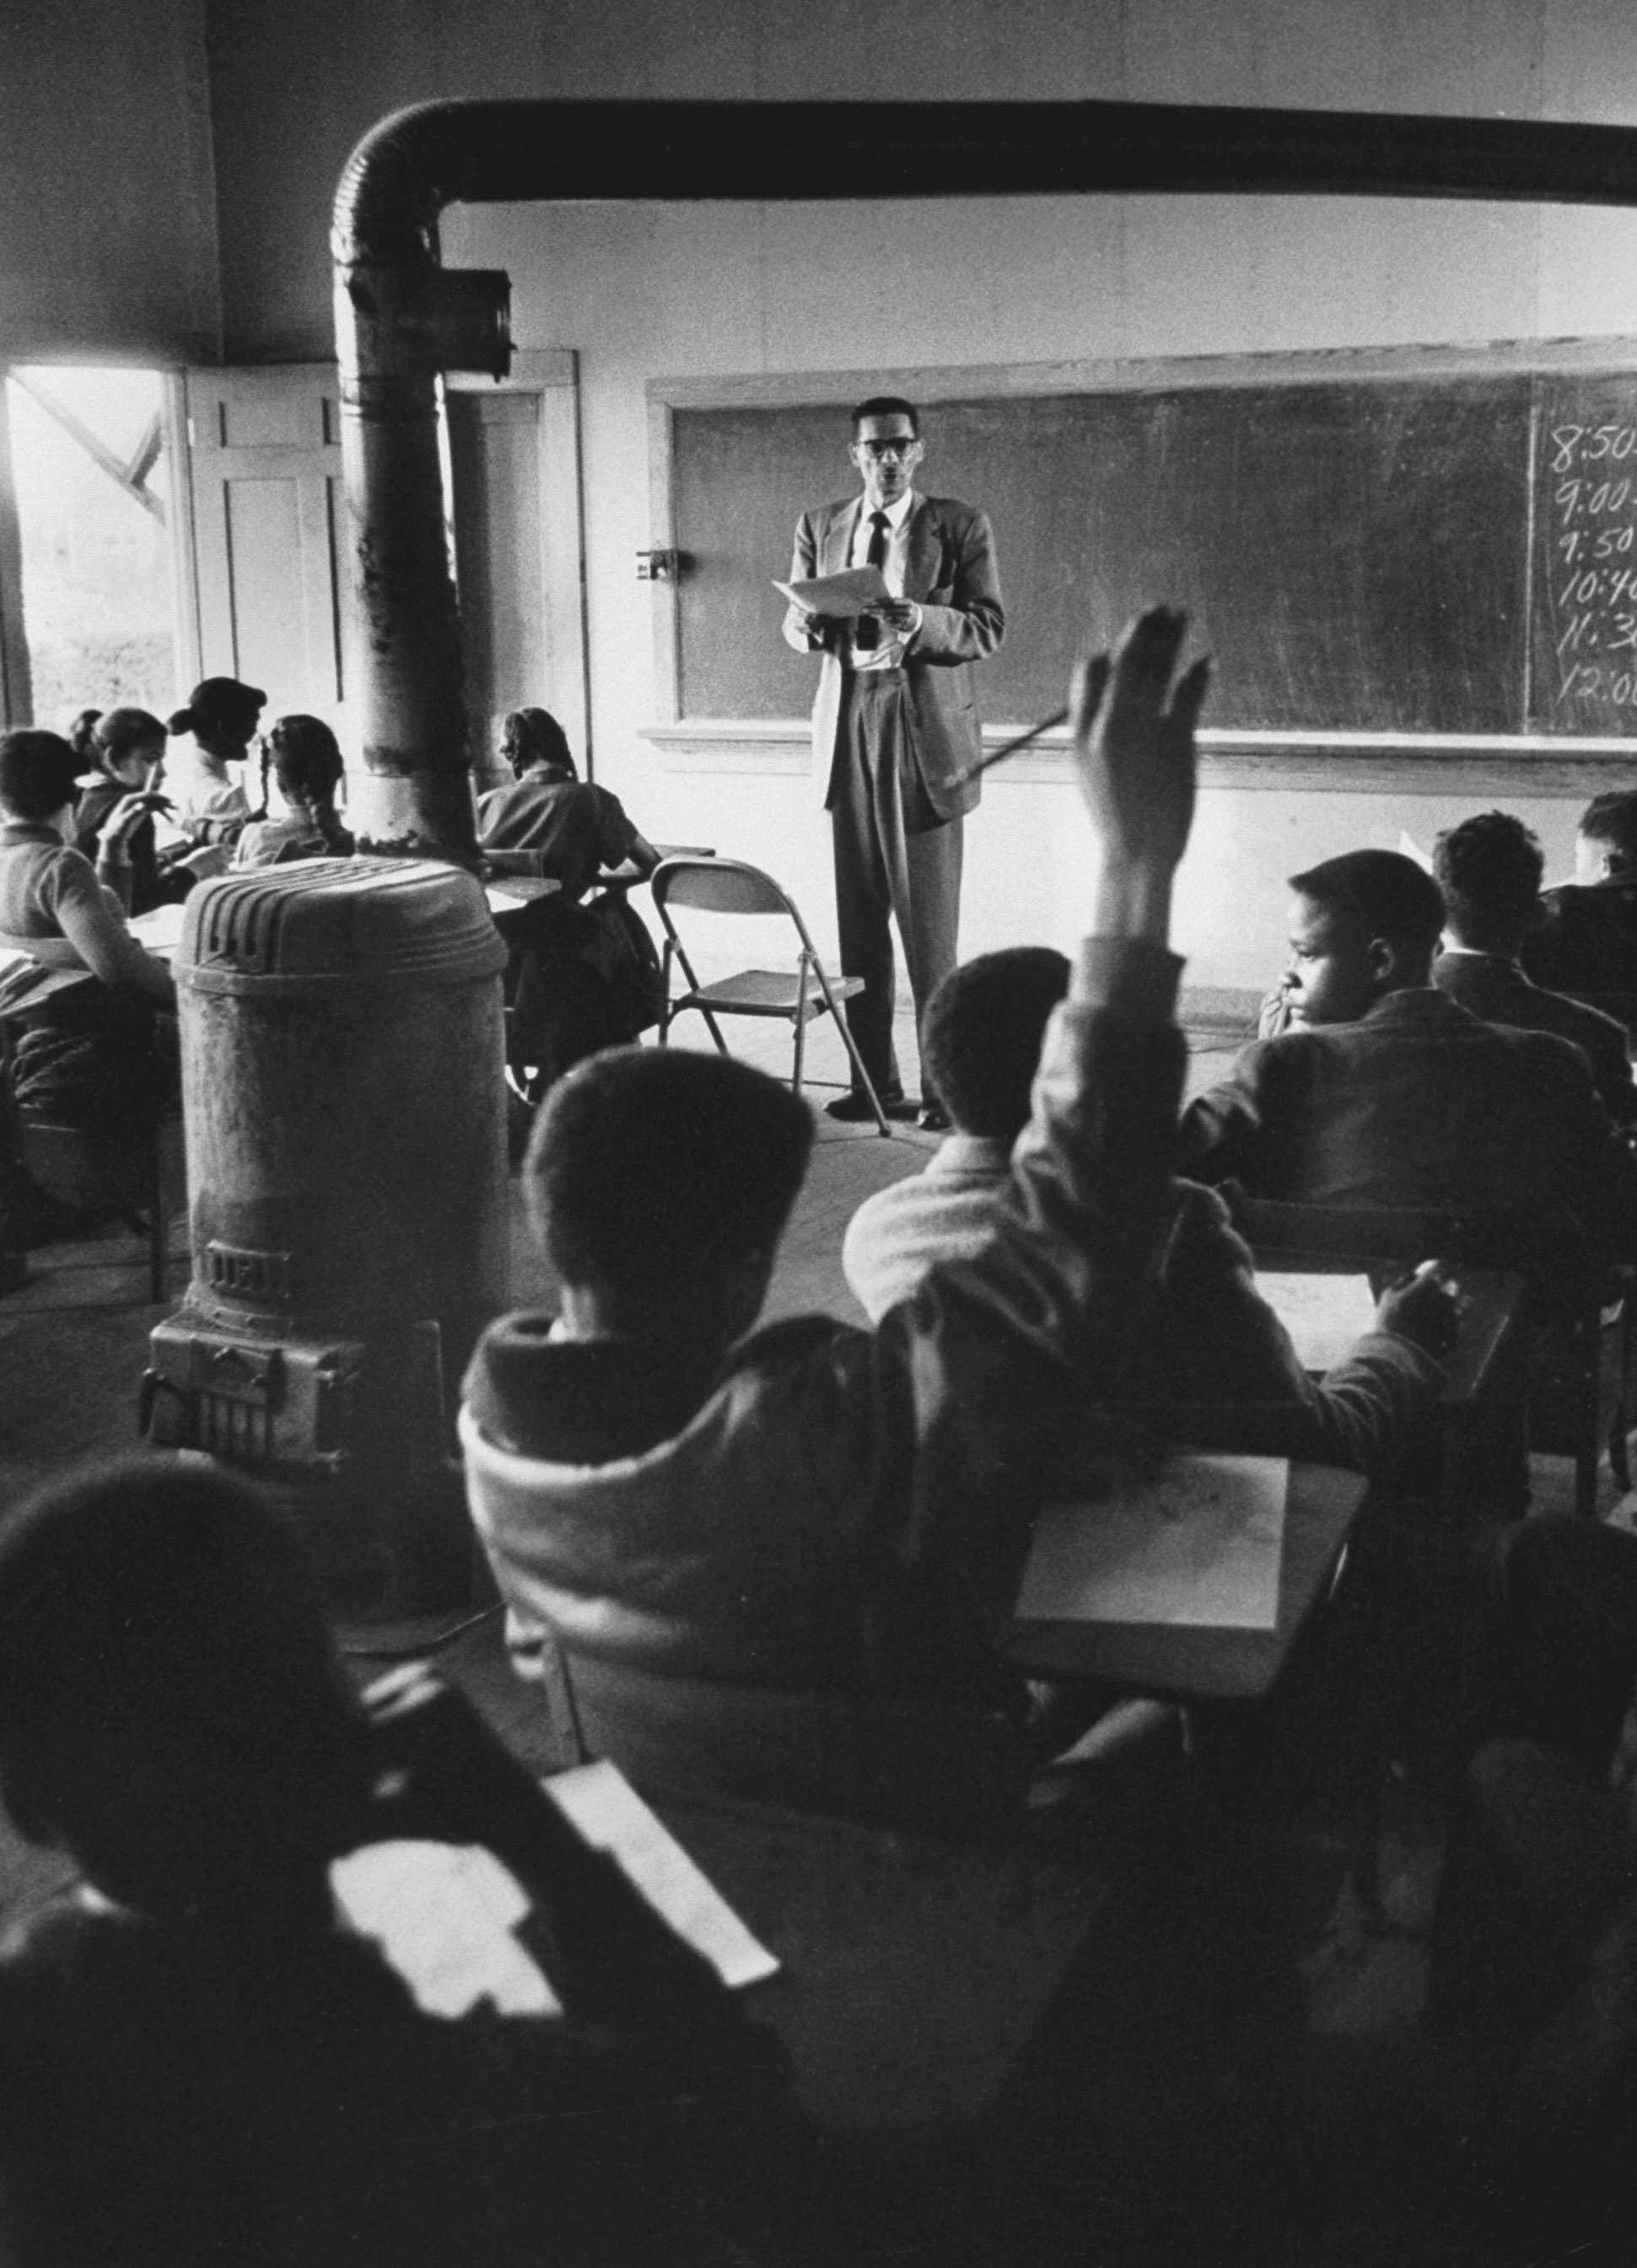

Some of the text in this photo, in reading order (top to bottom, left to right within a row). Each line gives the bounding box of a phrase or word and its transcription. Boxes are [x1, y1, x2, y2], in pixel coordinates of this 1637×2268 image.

[1552, 425, 1635, 472] 8:50
[1555, 478, 1630, 524] 9:00
[1559, 525, 1634, 564] 9:50
[1557, 611, 1637, 655] 11:3
